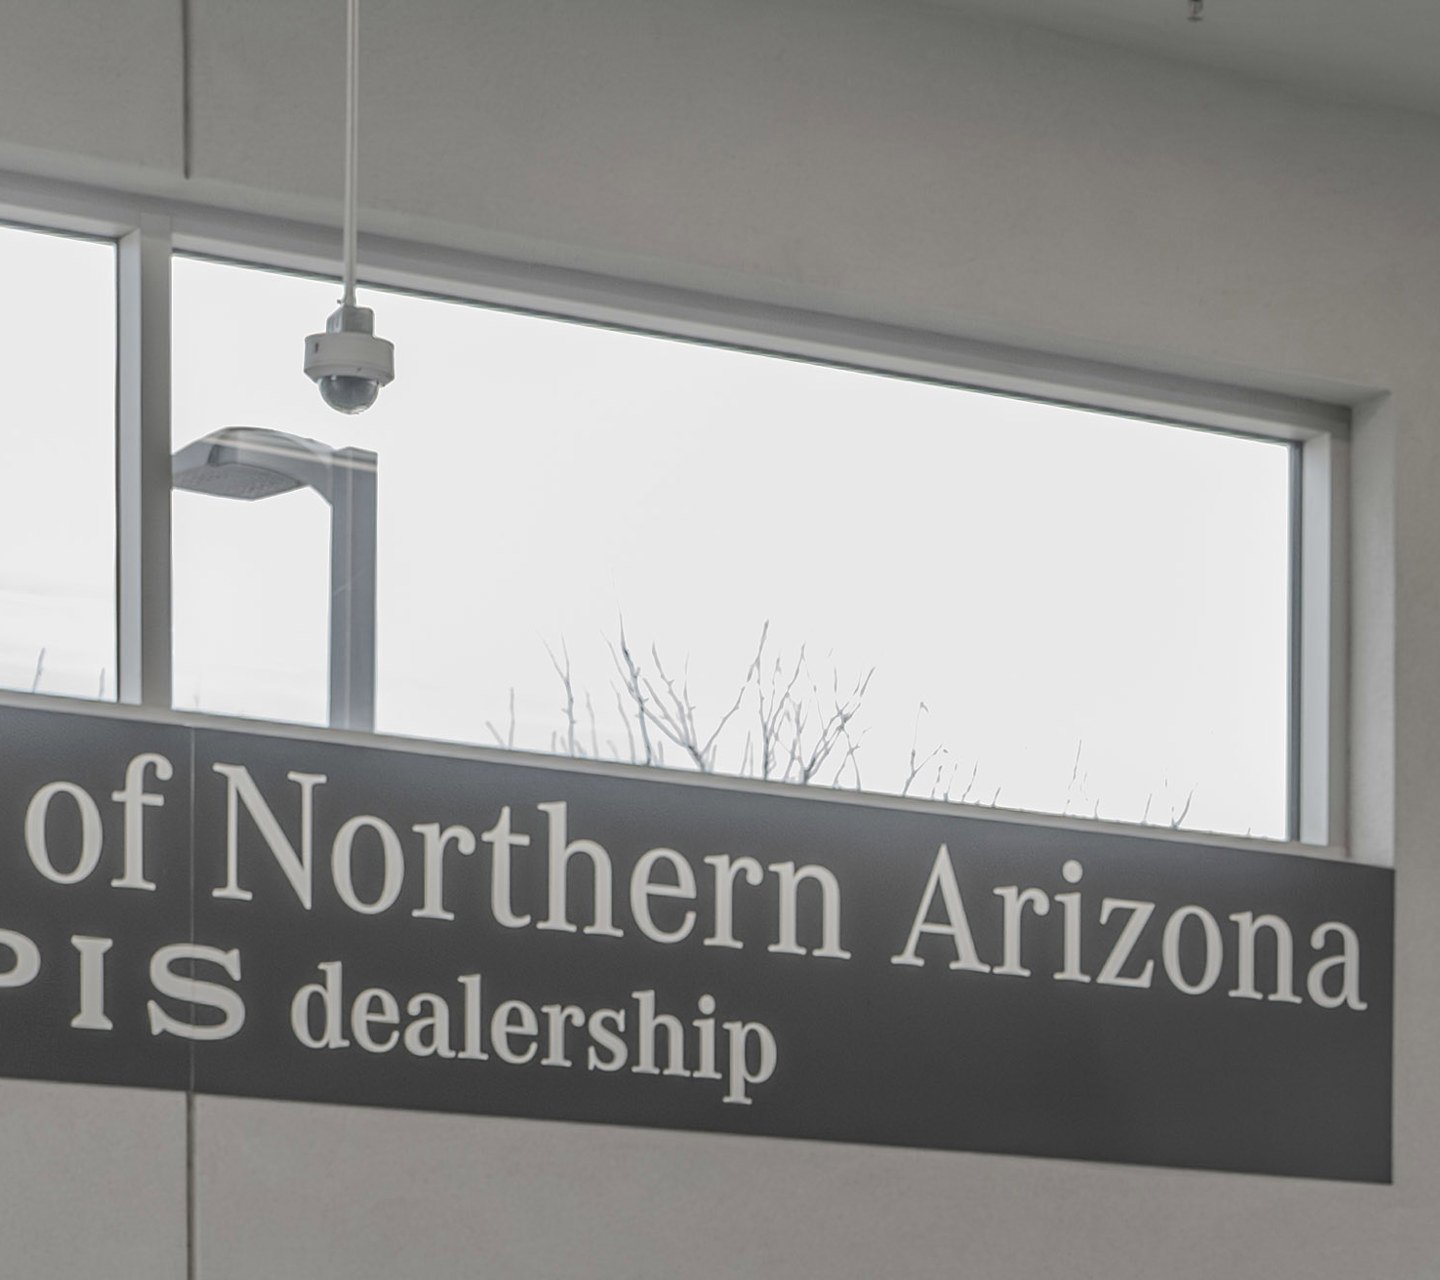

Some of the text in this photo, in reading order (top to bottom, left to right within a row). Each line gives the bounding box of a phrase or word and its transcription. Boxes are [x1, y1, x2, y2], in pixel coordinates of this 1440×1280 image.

[24, 752, 173, 891] of
[211, 762, 852, 960] Northern
[891, 844, 1368, 1011] Arizona
[291, 961, 777, 1105] dealership
